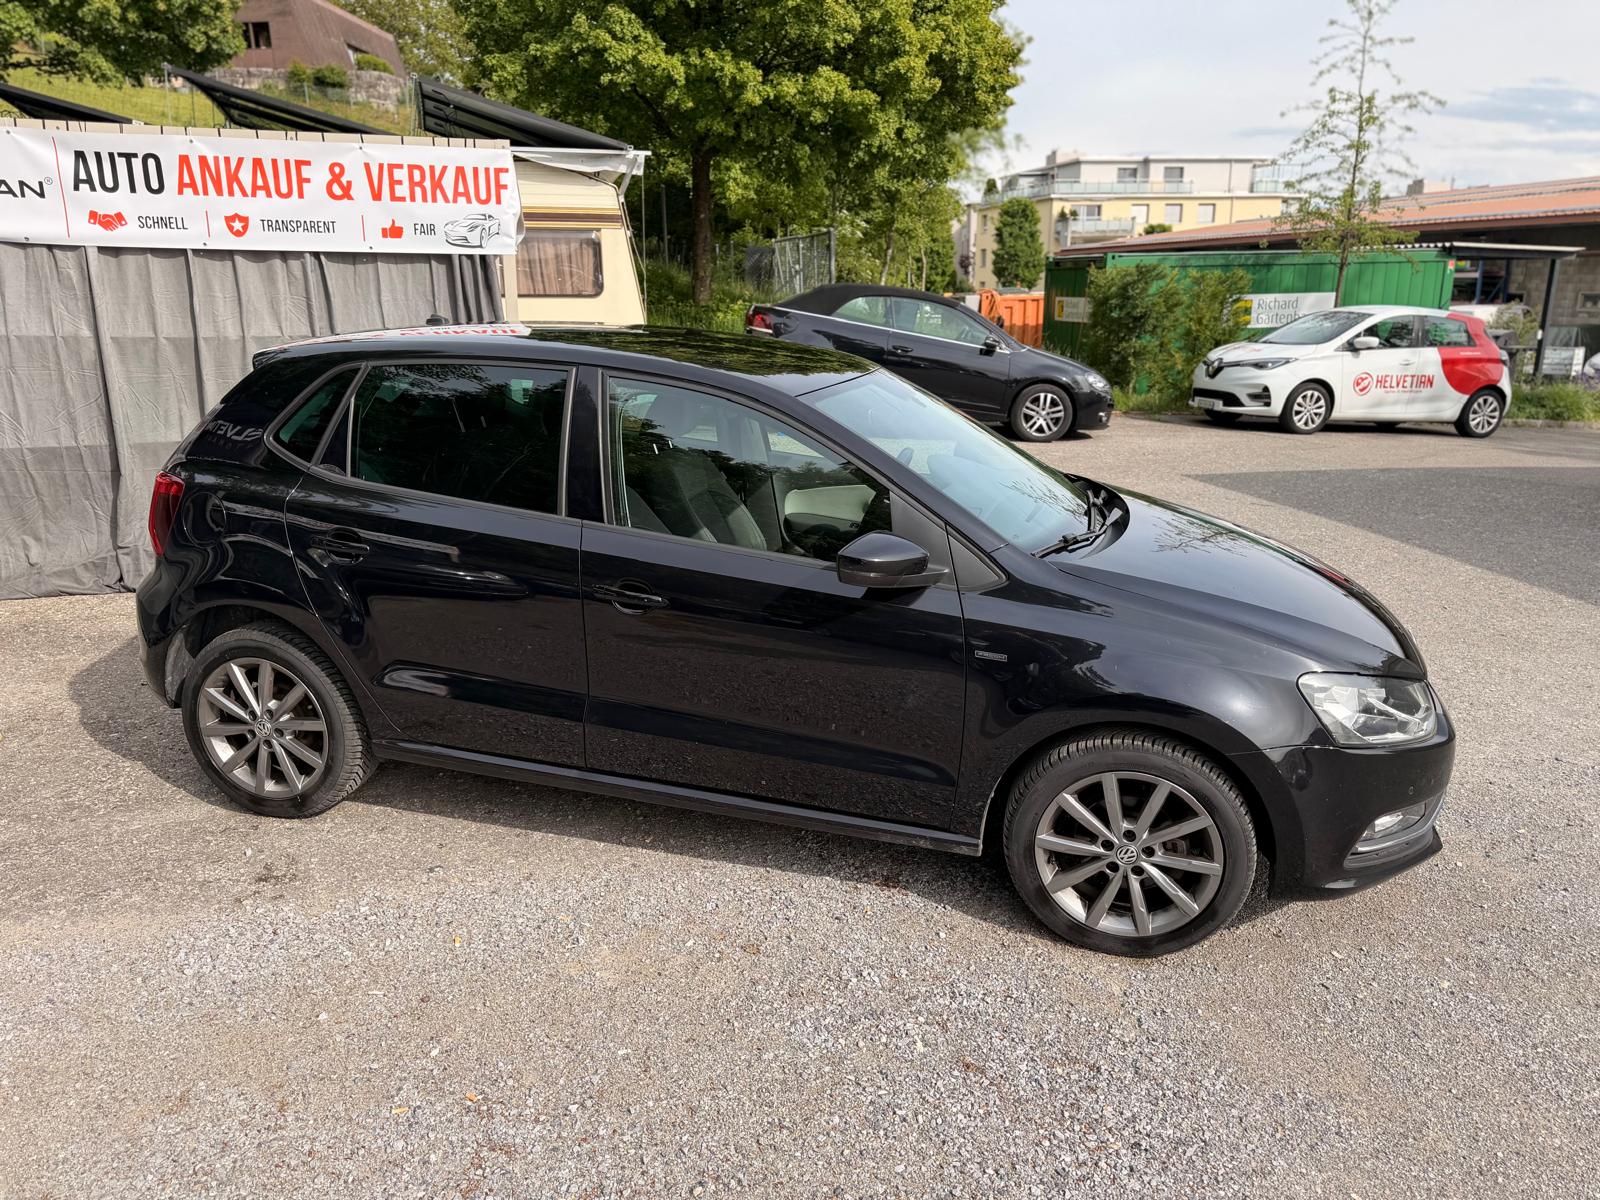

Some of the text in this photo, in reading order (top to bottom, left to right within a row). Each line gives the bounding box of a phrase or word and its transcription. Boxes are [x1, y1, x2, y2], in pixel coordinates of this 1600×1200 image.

[73, 150, 509, 205] AUTO ANKAUF & VERKAUF
[137, 215, 188, 230] SCHNELL
[260, 219, 336, 234] TRANSPARENT
[413, 223, 436, 236] FAIR
[1257, 296, 1299, 310] Richard
[1256, 311, 1305, 325] Gartenb
[1375, 374, 1434, 389] HELVETIAN
